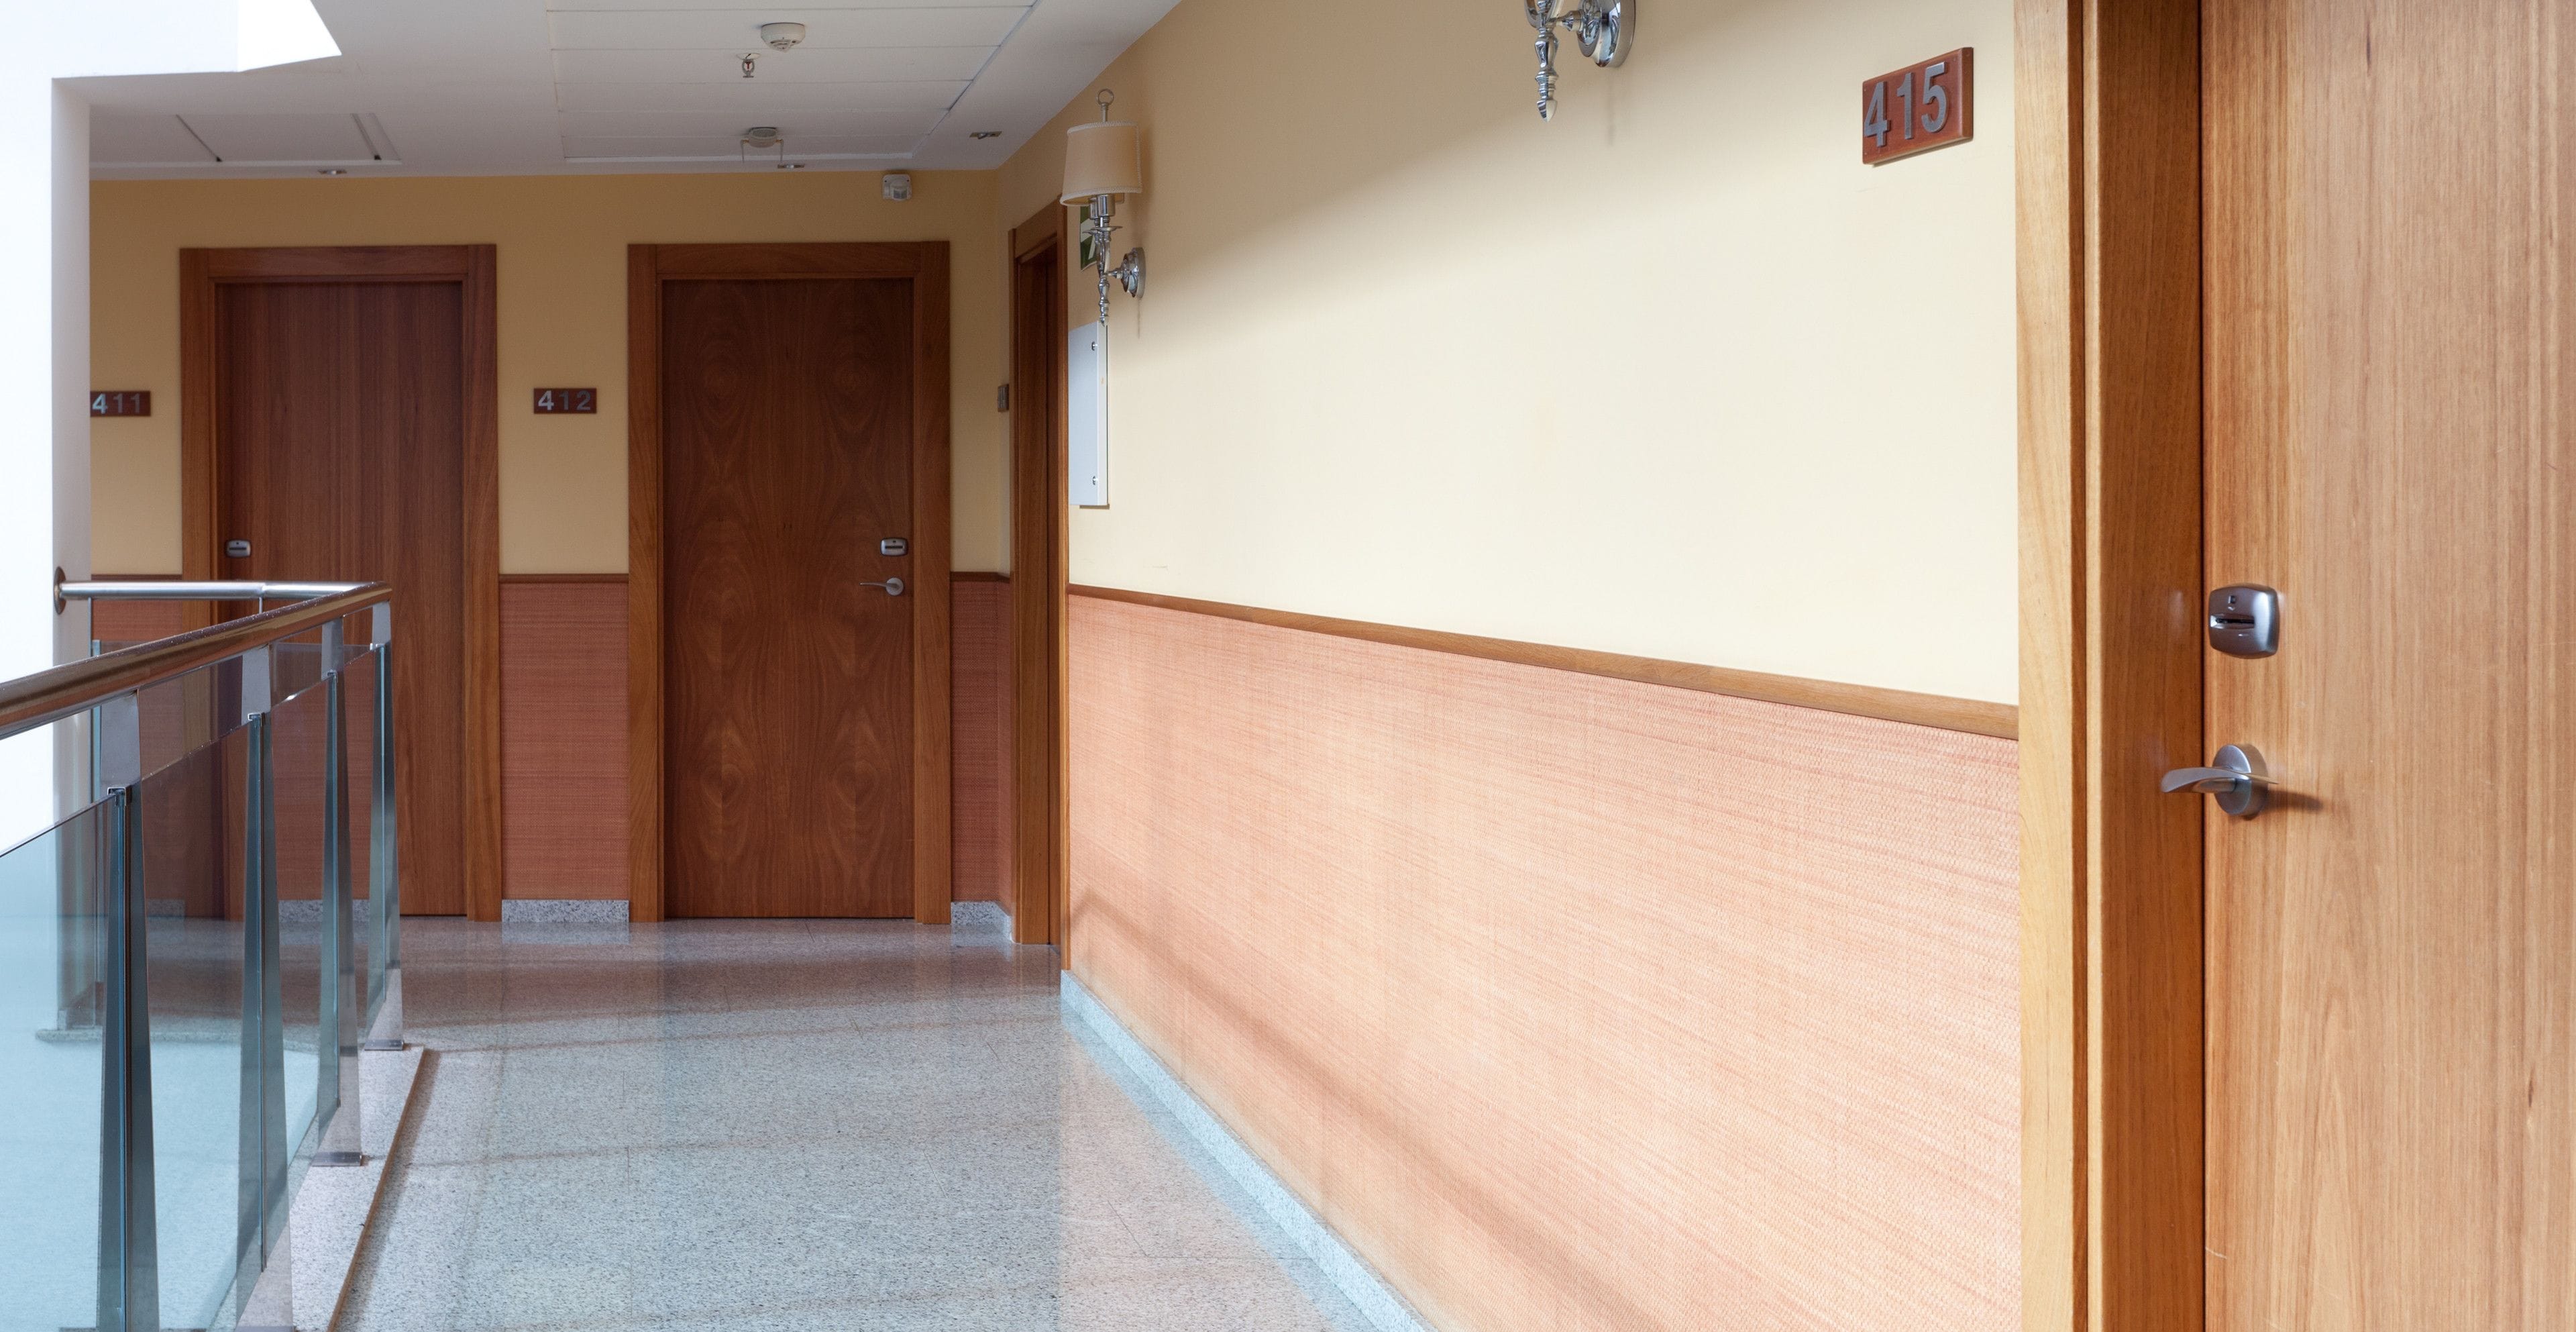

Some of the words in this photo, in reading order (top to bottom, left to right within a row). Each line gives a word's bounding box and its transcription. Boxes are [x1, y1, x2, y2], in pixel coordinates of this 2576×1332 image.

[1864, 61, 1948, 147] 415
[92, 393, 140, 414] 411
[537, 390, 591, 411] 412
